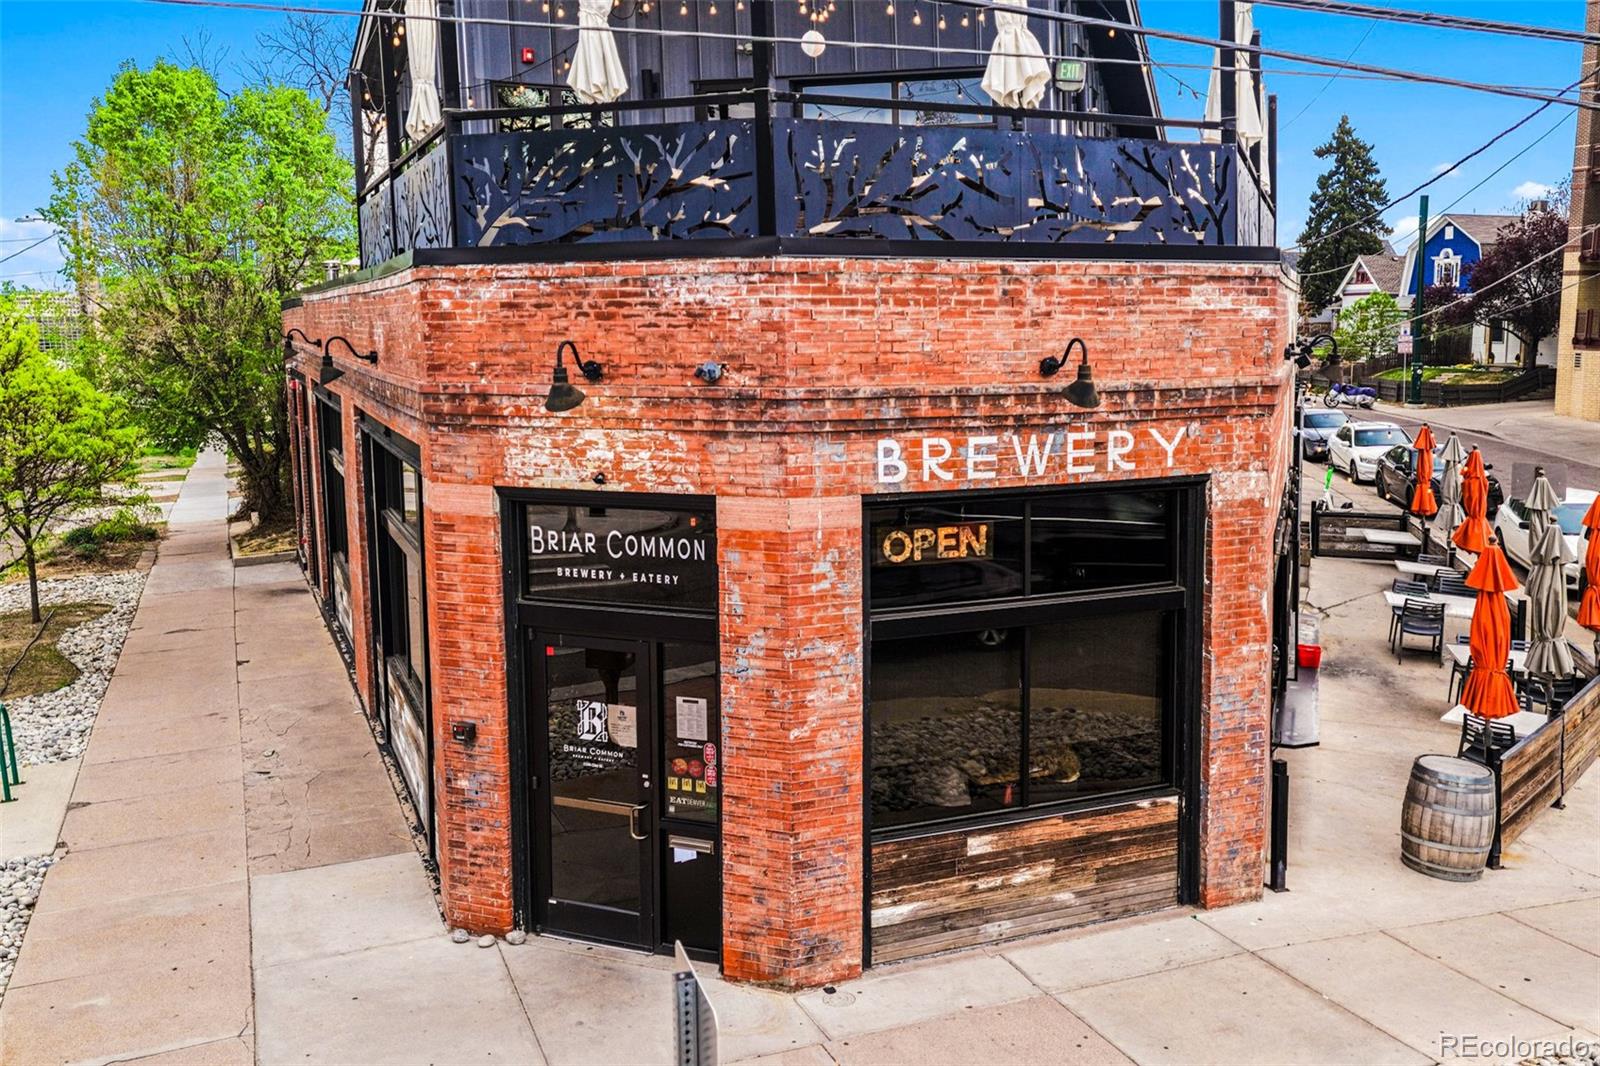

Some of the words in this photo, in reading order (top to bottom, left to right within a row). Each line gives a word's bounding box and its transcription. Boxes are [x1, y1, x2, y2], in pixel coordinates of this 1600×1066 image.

[1060, 63, 1081, 79] EXIT
[876, 426, 1188, 484] BREWERY
[530, 525, 597, 554] BRIAR
[606, 530, 706, 561] COMMON
[882, 524, 988, 563] OPEN
[556, 567, 613, 580] BREWERY
[632, 572, 680, 585] EATERY
[563, 743, 588, 753] BRIAR
[589, 747, 624, 758] COMMON
